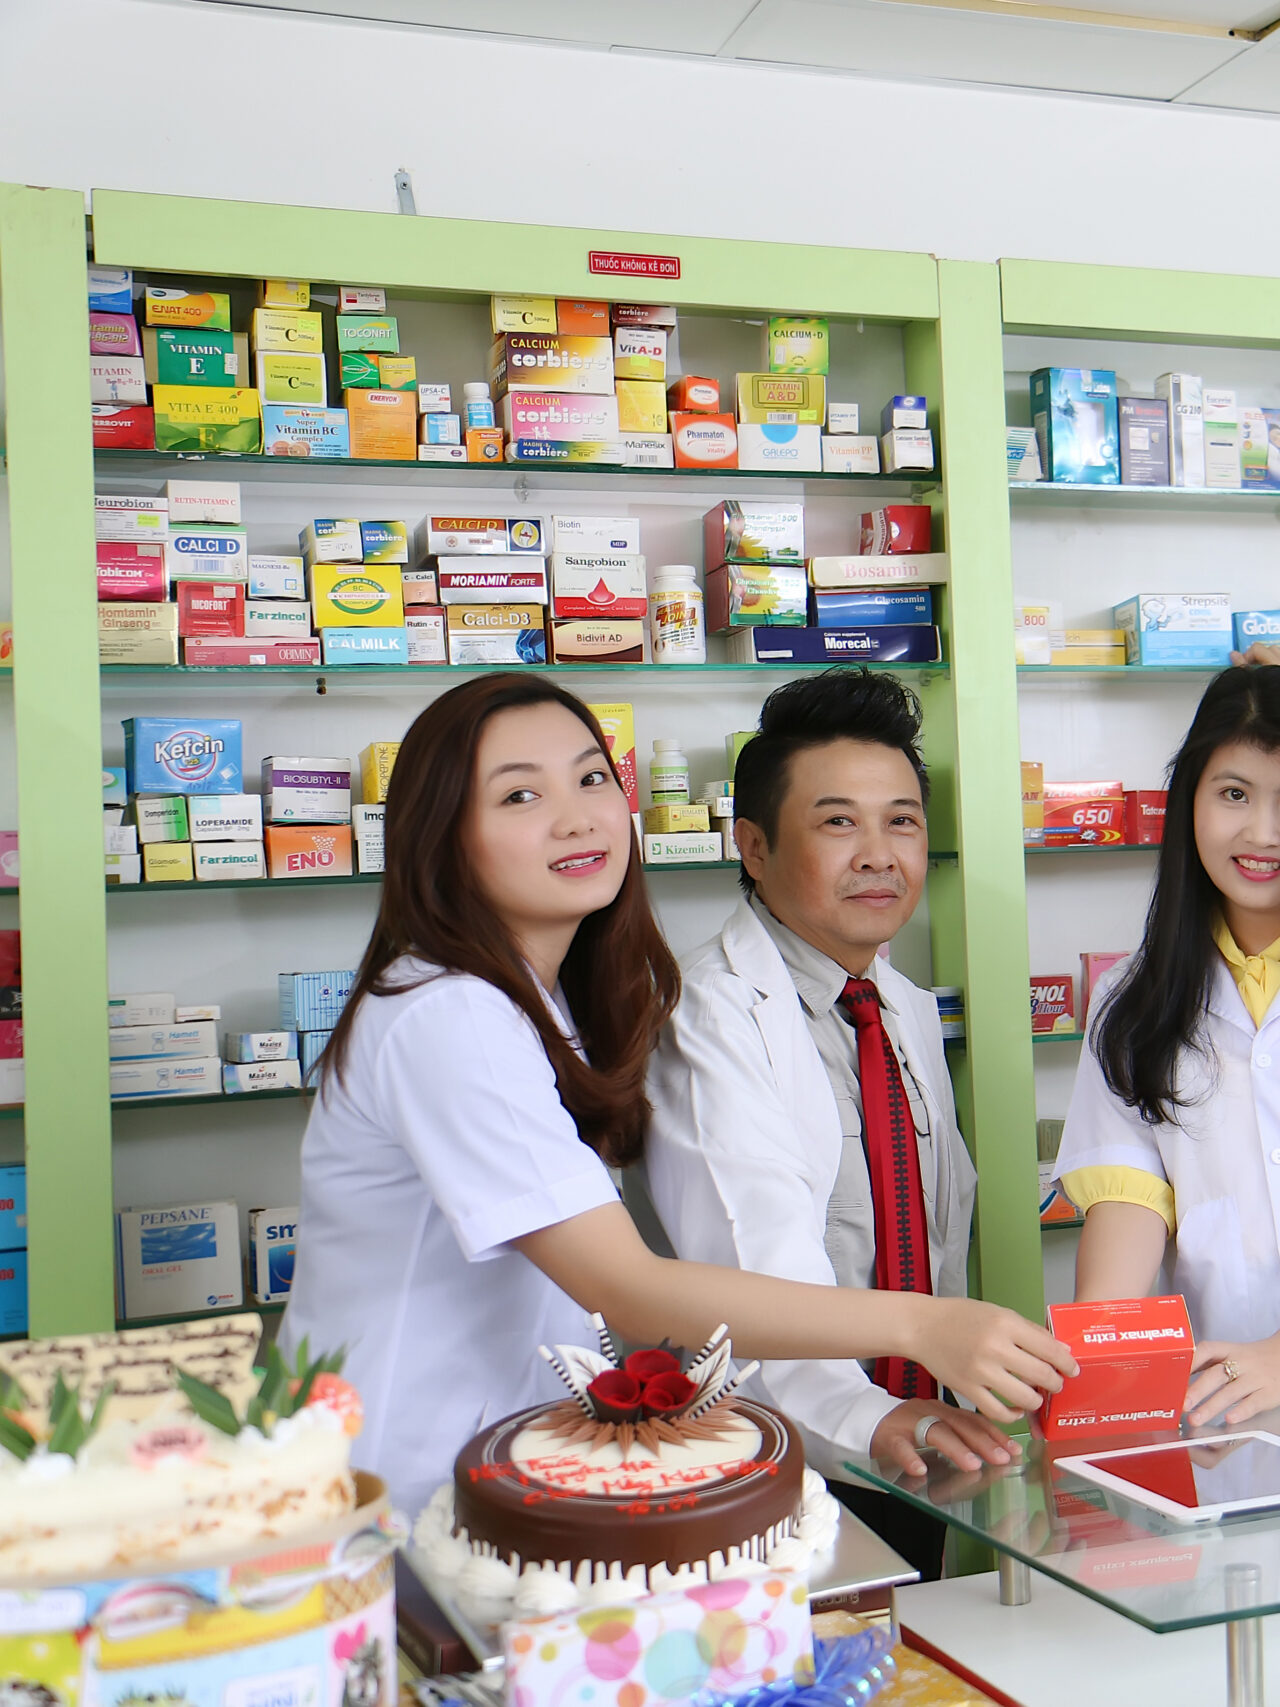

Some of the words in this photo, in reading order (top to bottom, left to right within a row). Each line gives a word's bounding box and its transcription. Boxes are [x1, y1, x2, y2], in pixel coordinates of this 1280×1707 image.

[595, 257, 619, 269] THUỐC
[621, 260, 646, 271] KHÔNG
[151, 304, 182, 315] ENAT
[184, 307, 202, 316] 400
[522, 312, 534, 324] C
[89, 324, 126, 334] itamin
[285, 328, 298, 342] C
[343, 328, 393, 339] TOCONAT
[170, 344, 222, 356] VITAMIN
[510, 338, 560, 350] CALCIUM
[189, 357, 205, 375] E
[511, 351, 608, 370] corbière
[92, 367, 132, 376] ITAMIN
[288, 376, 299, 389] C
[762, 383, 800, 391] VITAMIN
[420, 386, 446, 395] UPSA-C
[370, 394, 398, 403] ENERVON
[515, 397, 561, 406] CALCIUM
[168, 402, 201, 413] VITA
[205, 404, 214, 413] E
[217, 405, 238, 415] 400
[516, 407, 606, 425] corbière
[92, 419, 132, 427] ERROVIT
[275, 424, 320, 436] Vitamin
[322, 426, 339, 436] BC
[686, 430, 725, 440] Pharmaton
[829, 447, 859, 455] Vitamin
[861, 447, 873, 455] PP
[558, 520, 581, 528] Biotin
[178, 539, 219, 552] CALCI
[226, 541, 237, 552] D
[565, 556, 627, 569] Sangobion
[844, 562, 919, 579] Bosamin
[450, 574, 509, 587] MORIAMIN
[511, 578, 536, 586] FORTE
[874, 595, 925, 605] Glucosamin
[1181, 596, 1229, 608] Strepsils
[250, 611, 306, 621] Farzincol
[463, 612, 531, 626] Calci-D3
[1024, 615, 1046, 626] 800
[102, 619, 151, 630] Ginseng
[433, 620, 440, 628] C
[328, 637, 400, 651] CALMILK
[576, 633, 606, 643] Bidivit
[608, 634, 623, 643] AD
[824, 637, 871, 650] Morecal
[154, 735, 225, 764] Kefcin
[283, 775, 341, 785] BIOSUBTYL-II
[364, 812, 385, 821] Imo
[1073, 808, 1110, 826] 650
[196, 819, 253, 827] LOPERAMIDE
[666, 844, 715, 855] Kizemit-S
[200, 854, 258, 865] Farzincol
[287, 848, 334, 872] ENO
[1039, 1003, 1066, 1014] Hour
[140, 1207, 213, 1226] PEPSANE
[266, 1224, 297, 1240] sm
[1084, 1333, 1117, 1344] Extra
[1119, 1327, 1185, 1342] Paralmax
[1057, 1416, 1096, 1427] Extra
[1100, 1409, 1175, 1423] Paralmax
